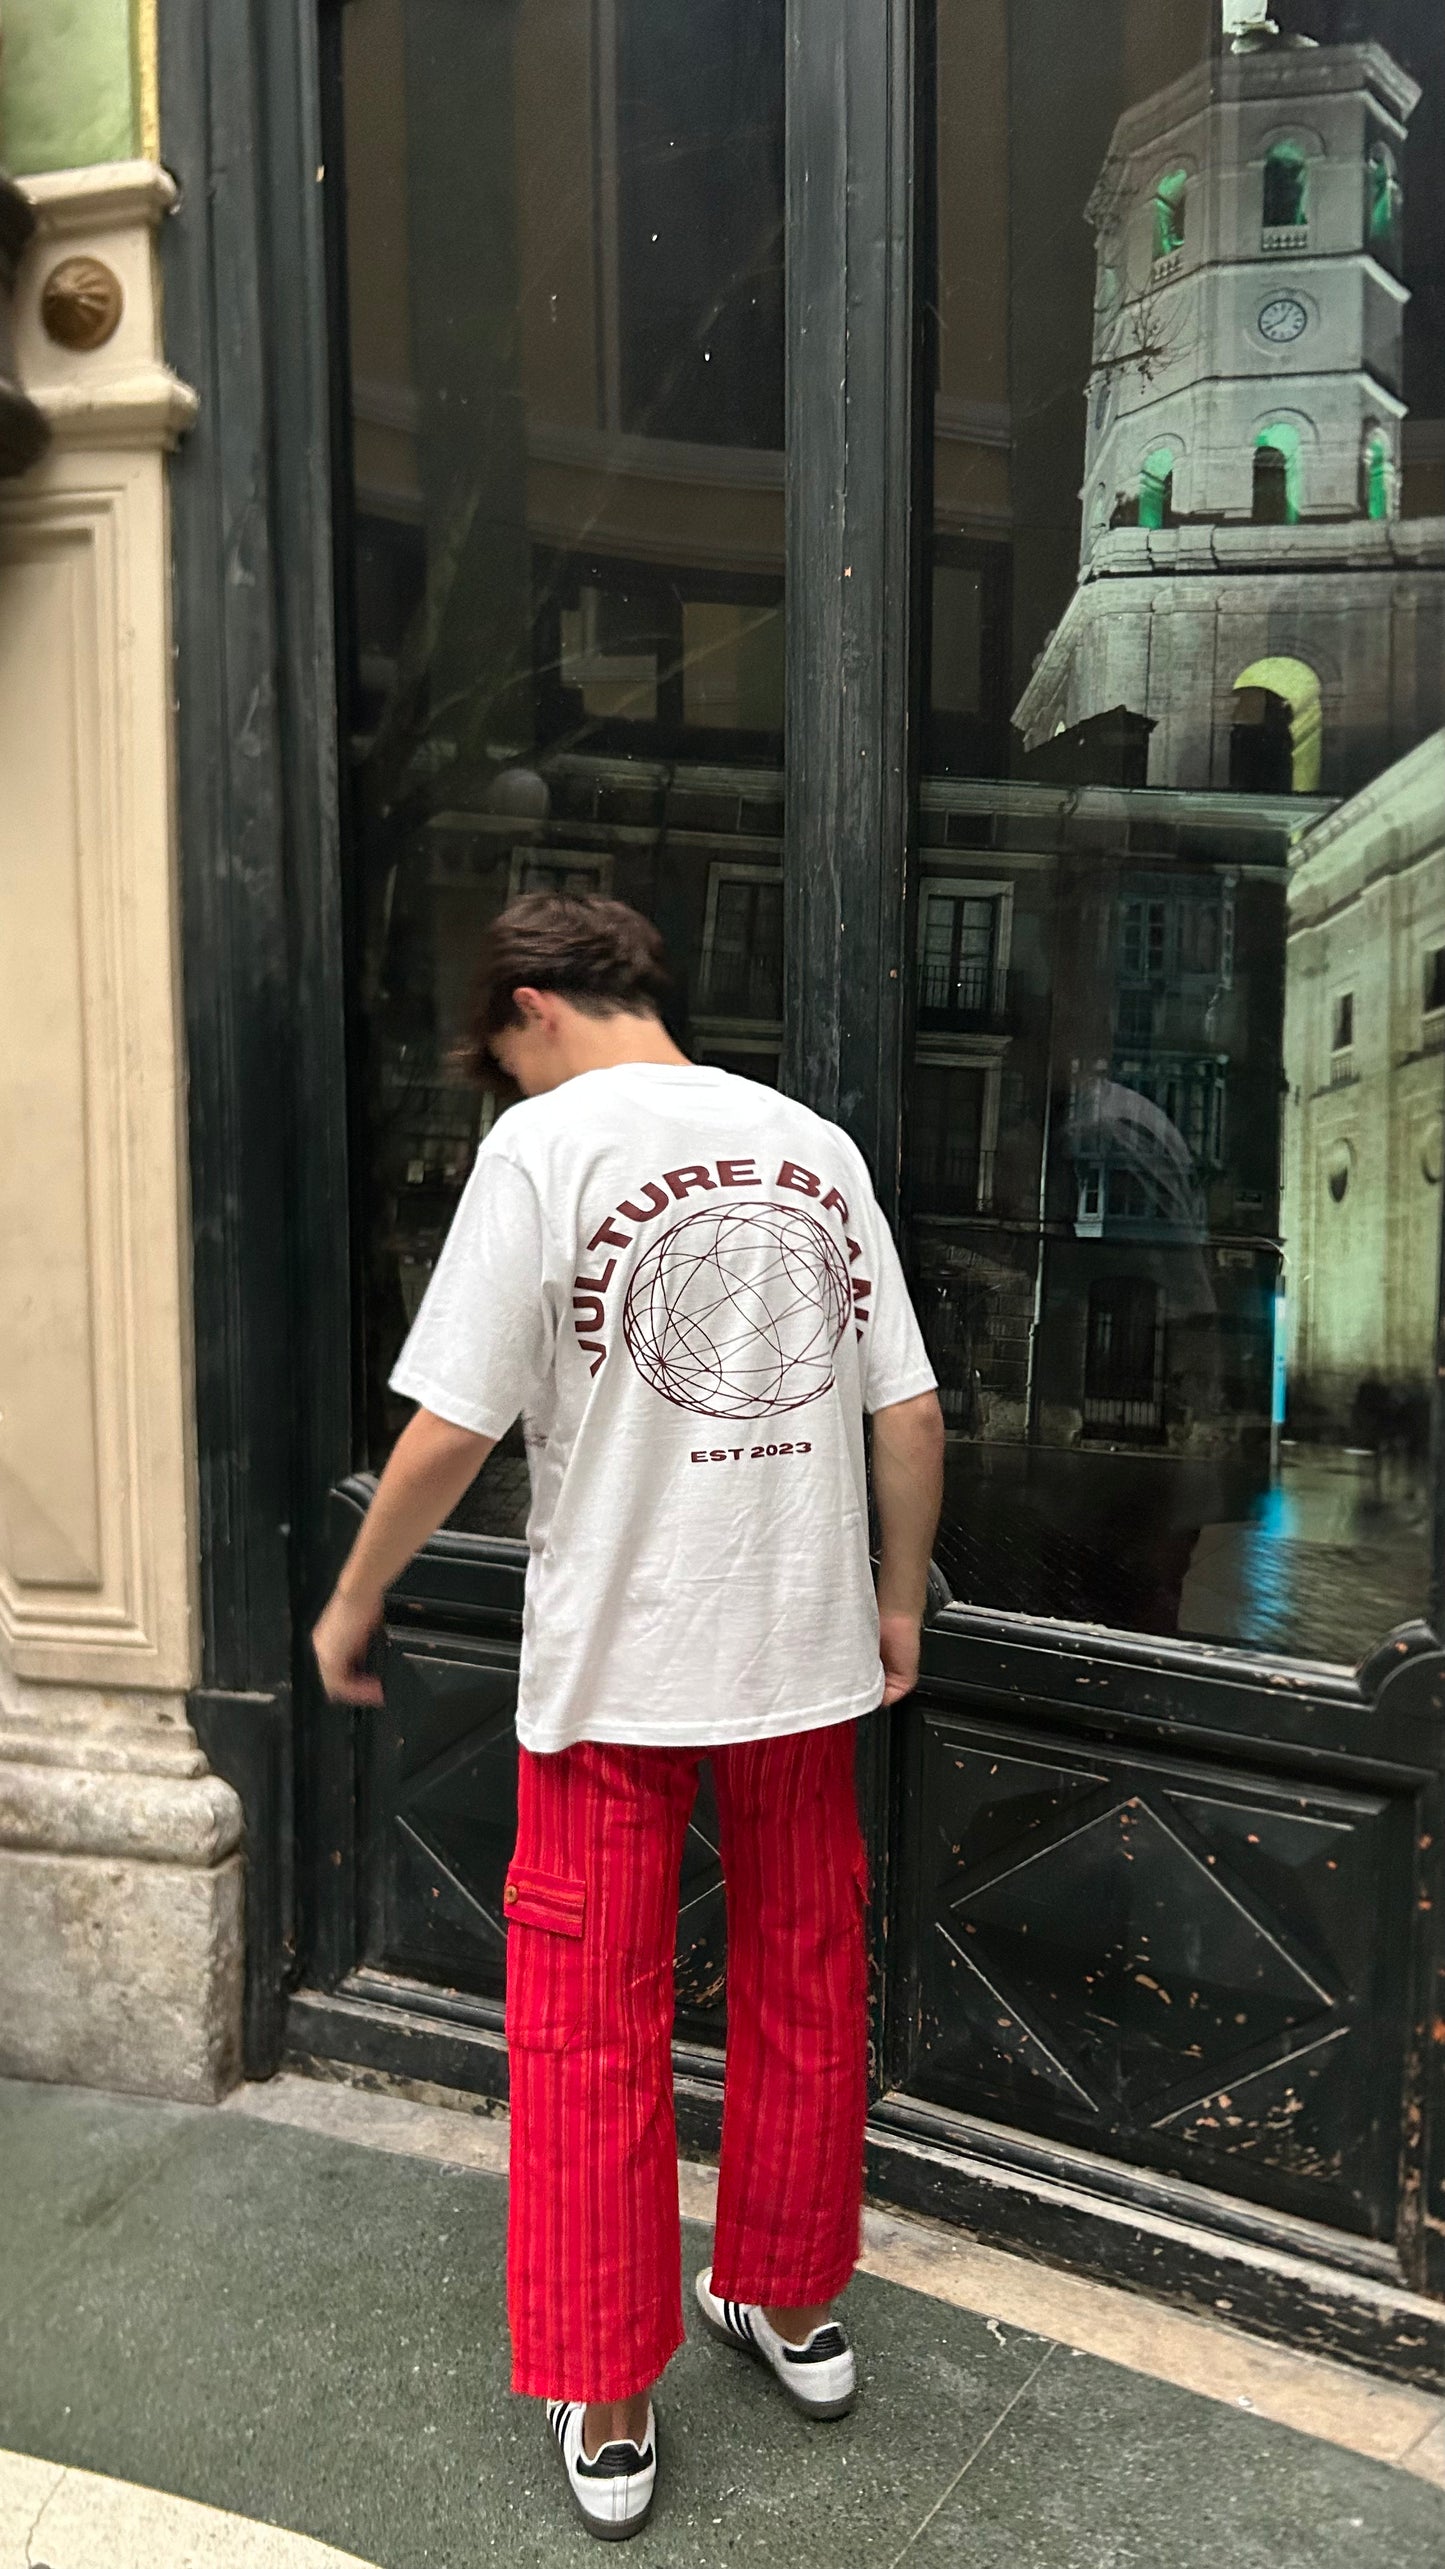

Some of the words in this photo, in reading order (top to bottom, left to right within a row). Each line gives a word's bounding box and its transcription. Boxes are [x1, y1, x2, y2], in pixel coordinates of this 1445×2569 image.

[573, 1158, 762, 1378] VULTURE
[691, 1448, 744, 1463] EST
[750, 1442, 812, 1459] 2023
